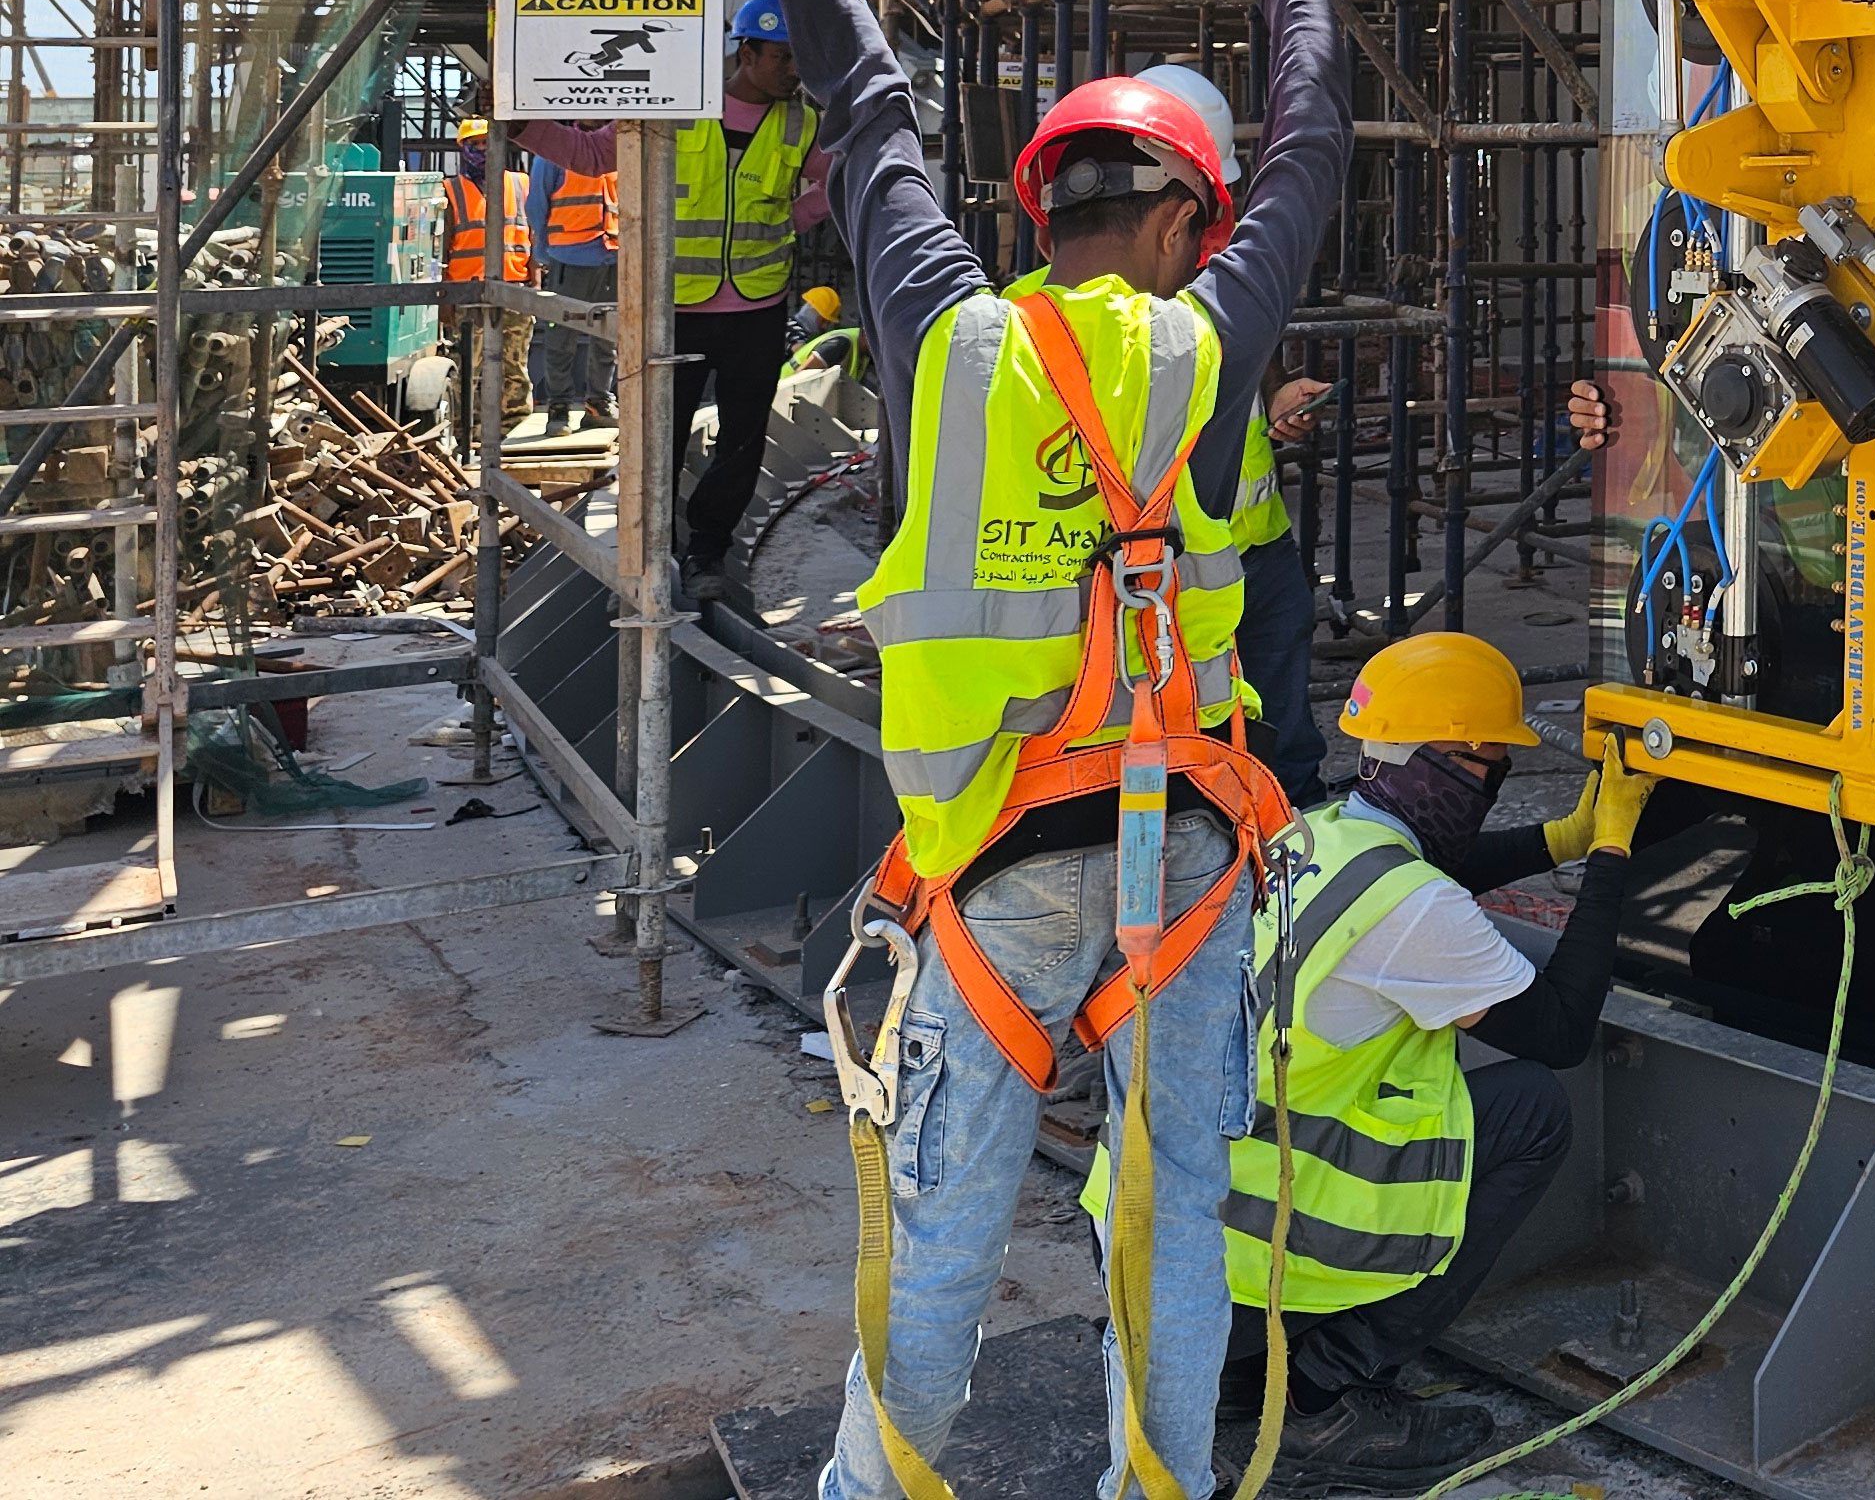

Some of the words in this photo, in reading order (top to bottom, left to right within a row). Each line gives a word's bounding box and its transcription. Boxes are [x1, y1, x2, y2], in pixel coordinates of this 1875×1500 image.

[568, 86, 650, 94] WATCH
[543, 96, 609, 105] YOUR
[617, 96, 675, 106] STEP
[982, 519, 1038, 547] SIT
[980, 548, 1051, 565] Contracting
